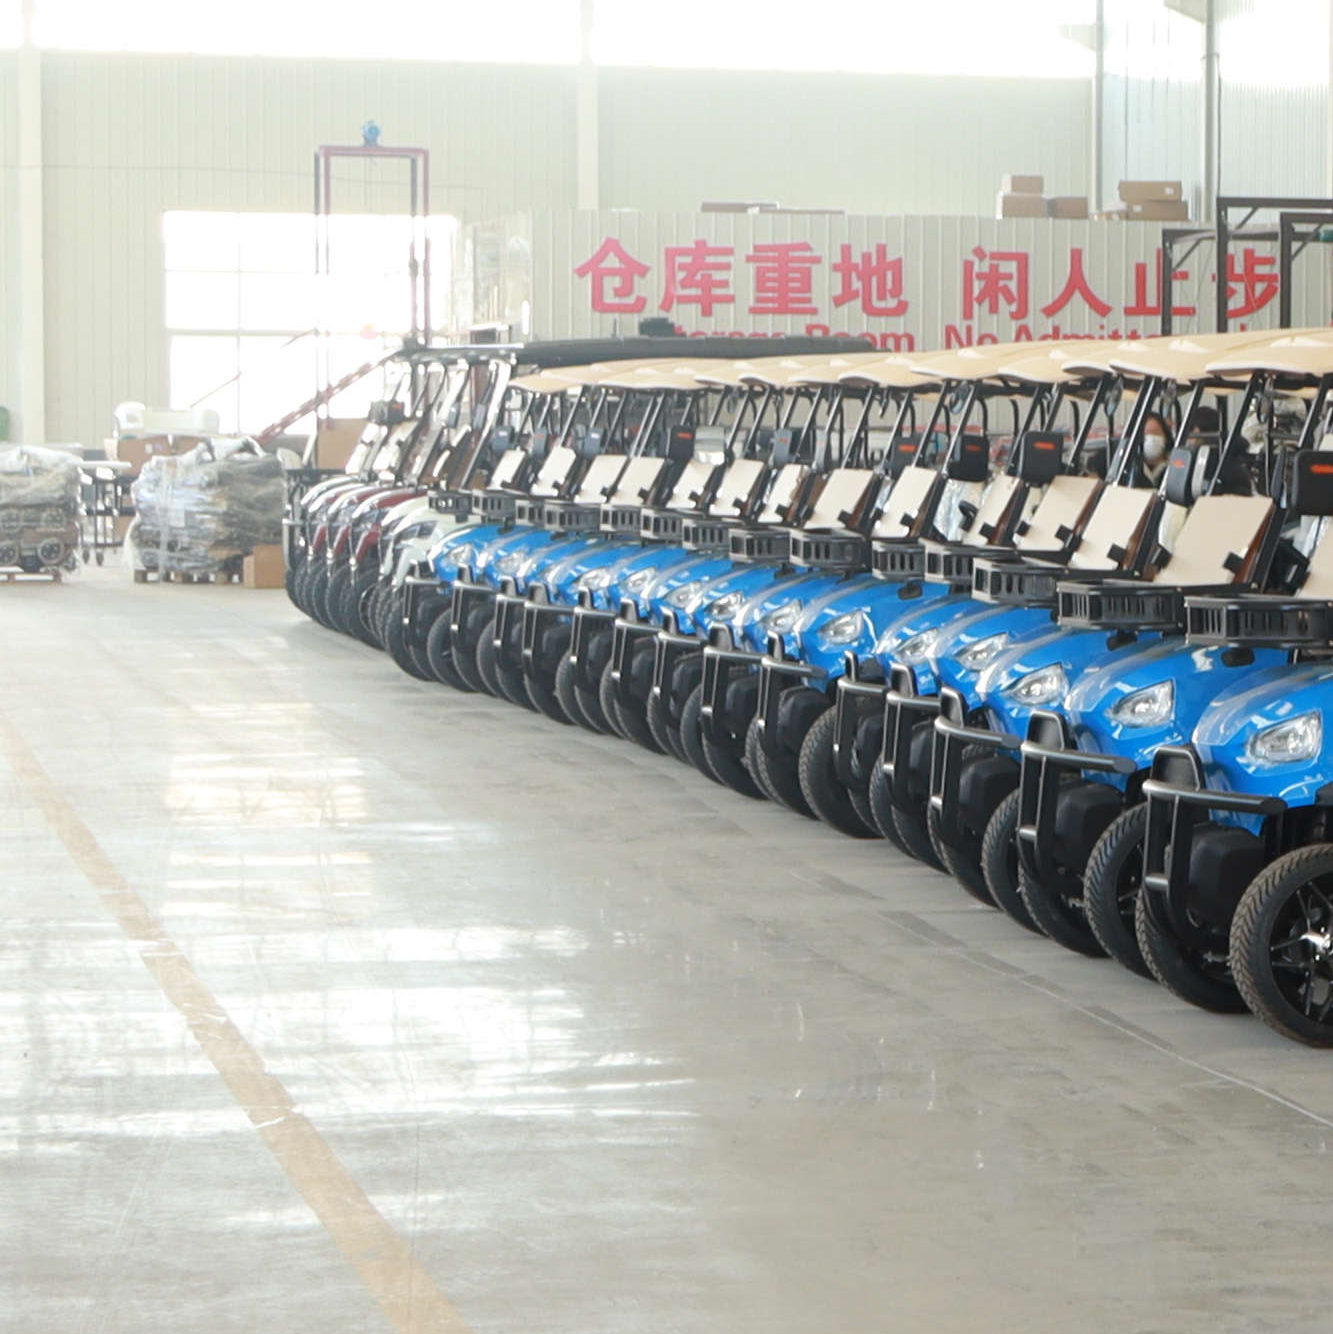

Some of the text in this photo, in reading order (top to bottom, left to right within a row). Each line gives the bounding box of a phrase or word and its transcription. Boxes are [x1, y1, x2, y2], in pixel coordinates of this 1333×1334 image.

[575, 237, 1282, 323] 仓库重地 闲人止步
